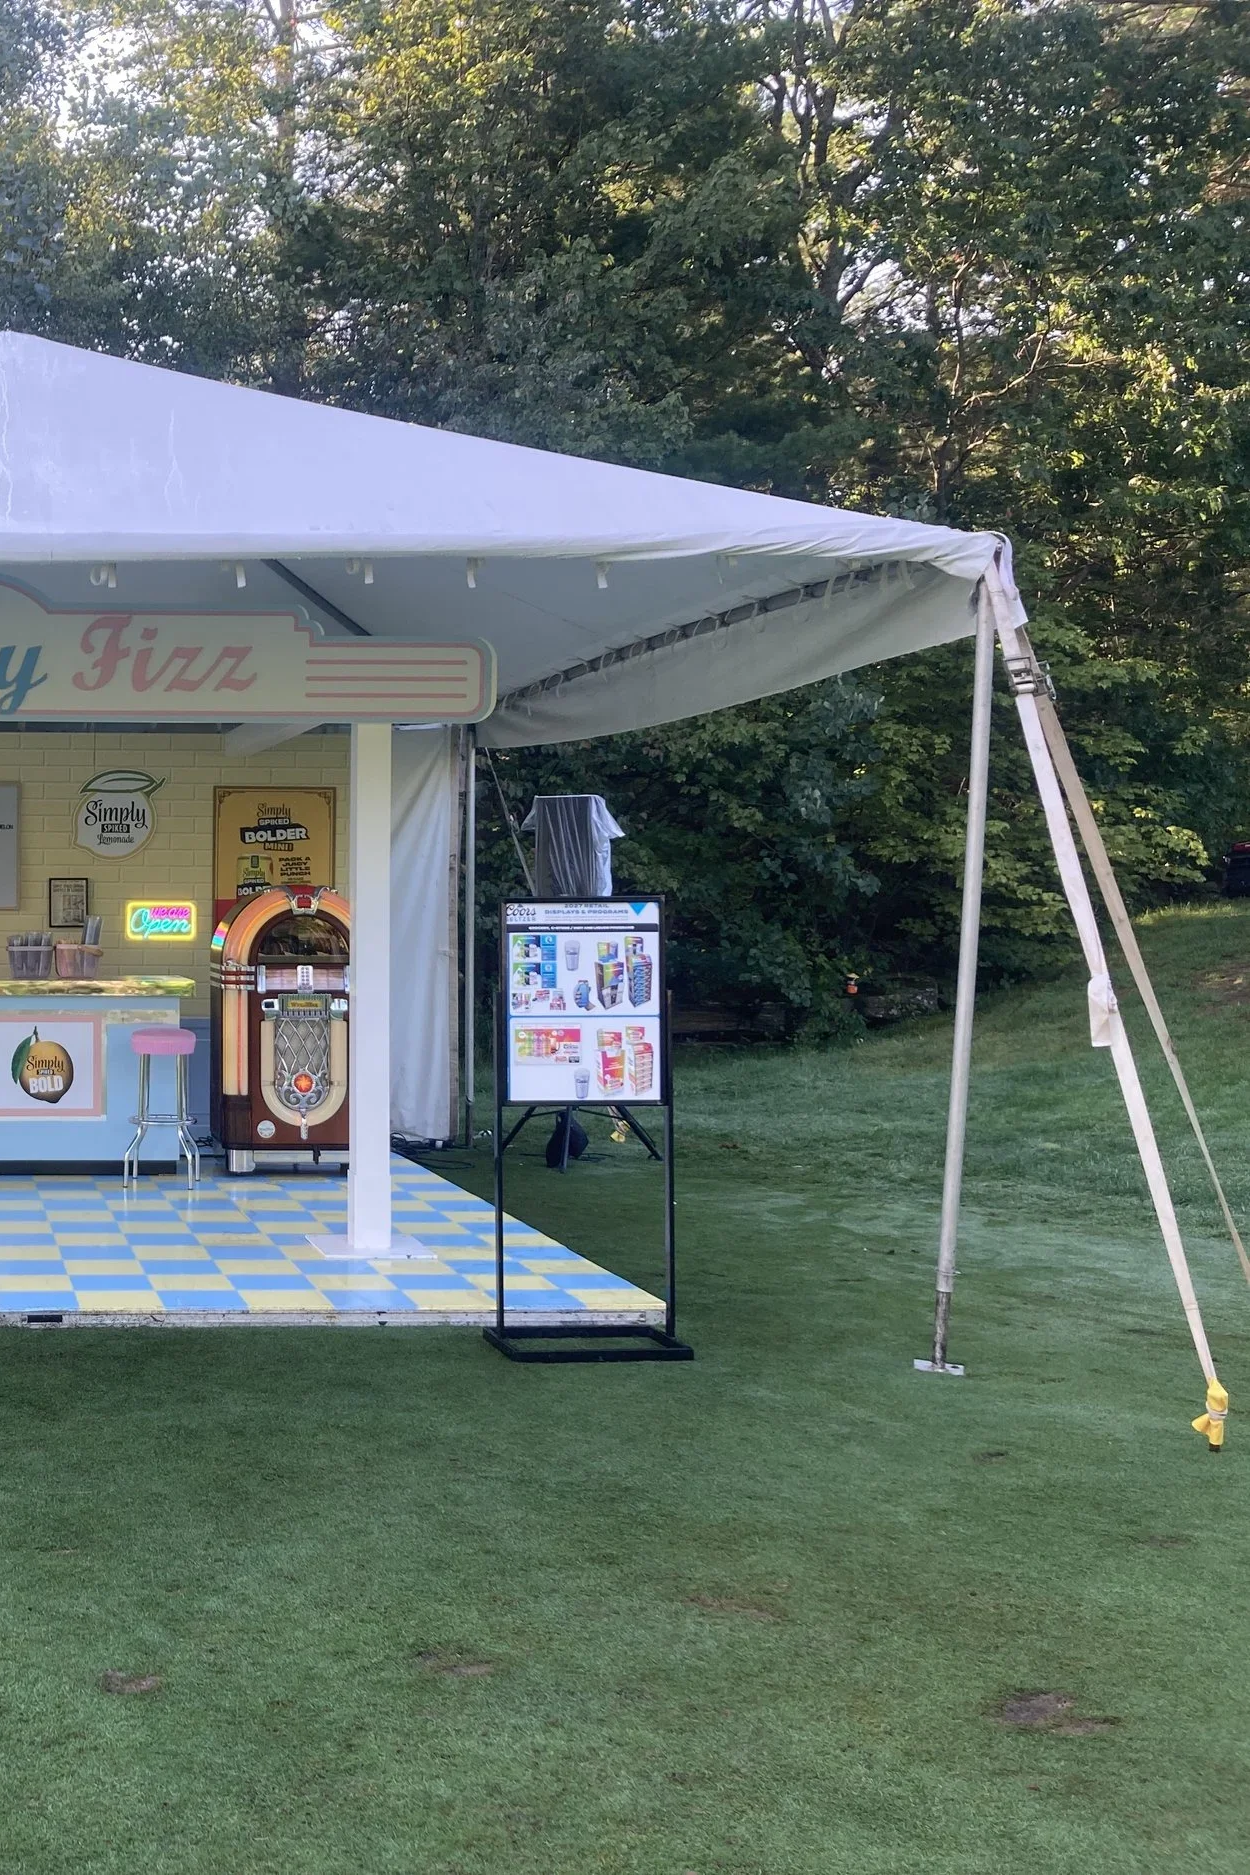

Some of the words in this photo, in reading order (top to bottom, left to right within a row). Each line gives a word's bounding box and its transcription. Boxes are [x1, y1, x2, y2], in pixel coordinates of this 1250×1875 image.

[72, 614, 258, 693] Fizz
[84, 799, 149, 829] Simply
[256, 802, 291, 819] Simply
[103, 824, 128, 833] SPIKED
[259, 818, 290, 826] SPIKED
[97, 834, 135, 846] Lemonade
[244, 827, 308, 844] BOLDER
[506, 903, 536, 917] Coors
[131, 907, 192, 938] Open
[26, 1055, 65, 1073] Simply
[29, 1075, 64, 1094] BOLD
